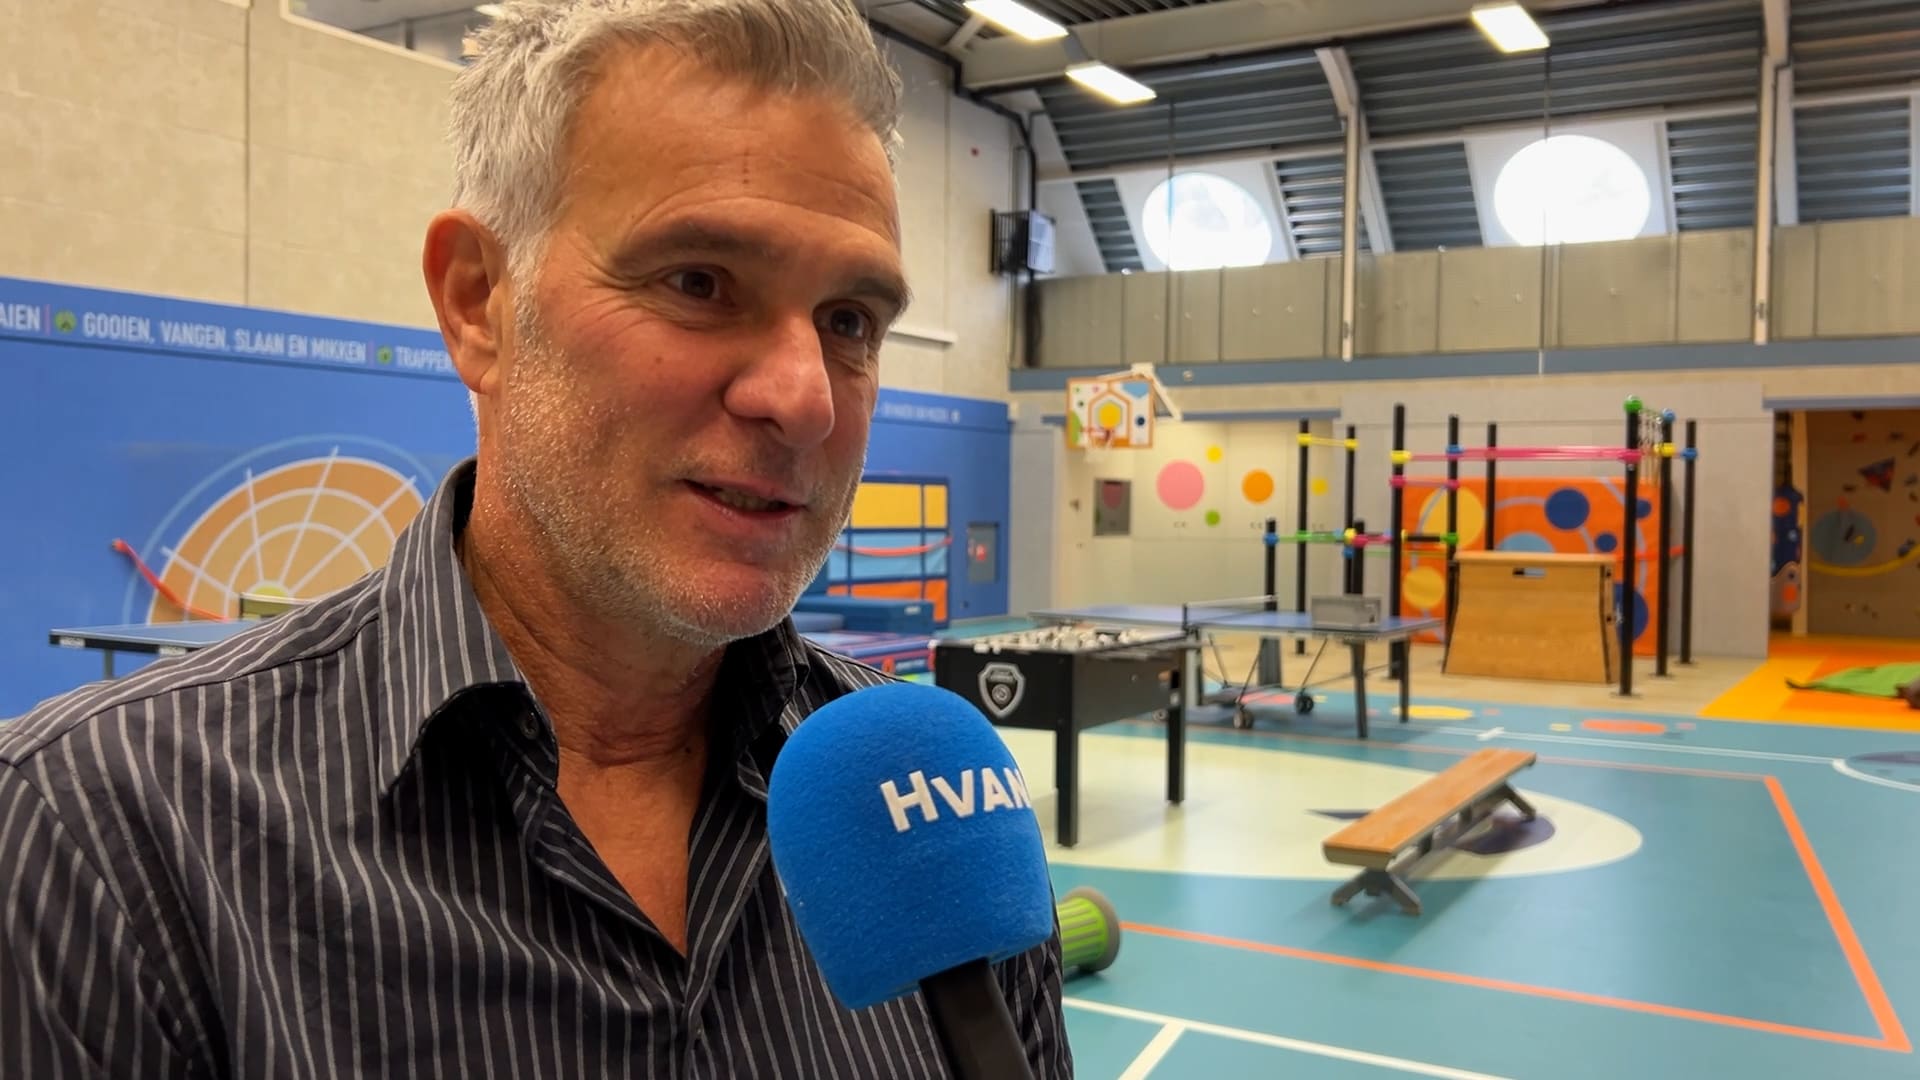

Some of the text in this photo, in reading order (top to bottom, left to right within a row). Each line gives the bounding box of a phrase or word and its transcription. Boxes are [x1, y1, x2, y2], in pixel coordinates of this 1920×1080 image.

[82, 311, 155, 344] GOOIEN,
[160, 319, 231, 351] VANGEN,
[234, 327, 285, 356] SLAAN
[287, 333, 308, 358] EN
[311, 336, 366, 364] MIKKEN
